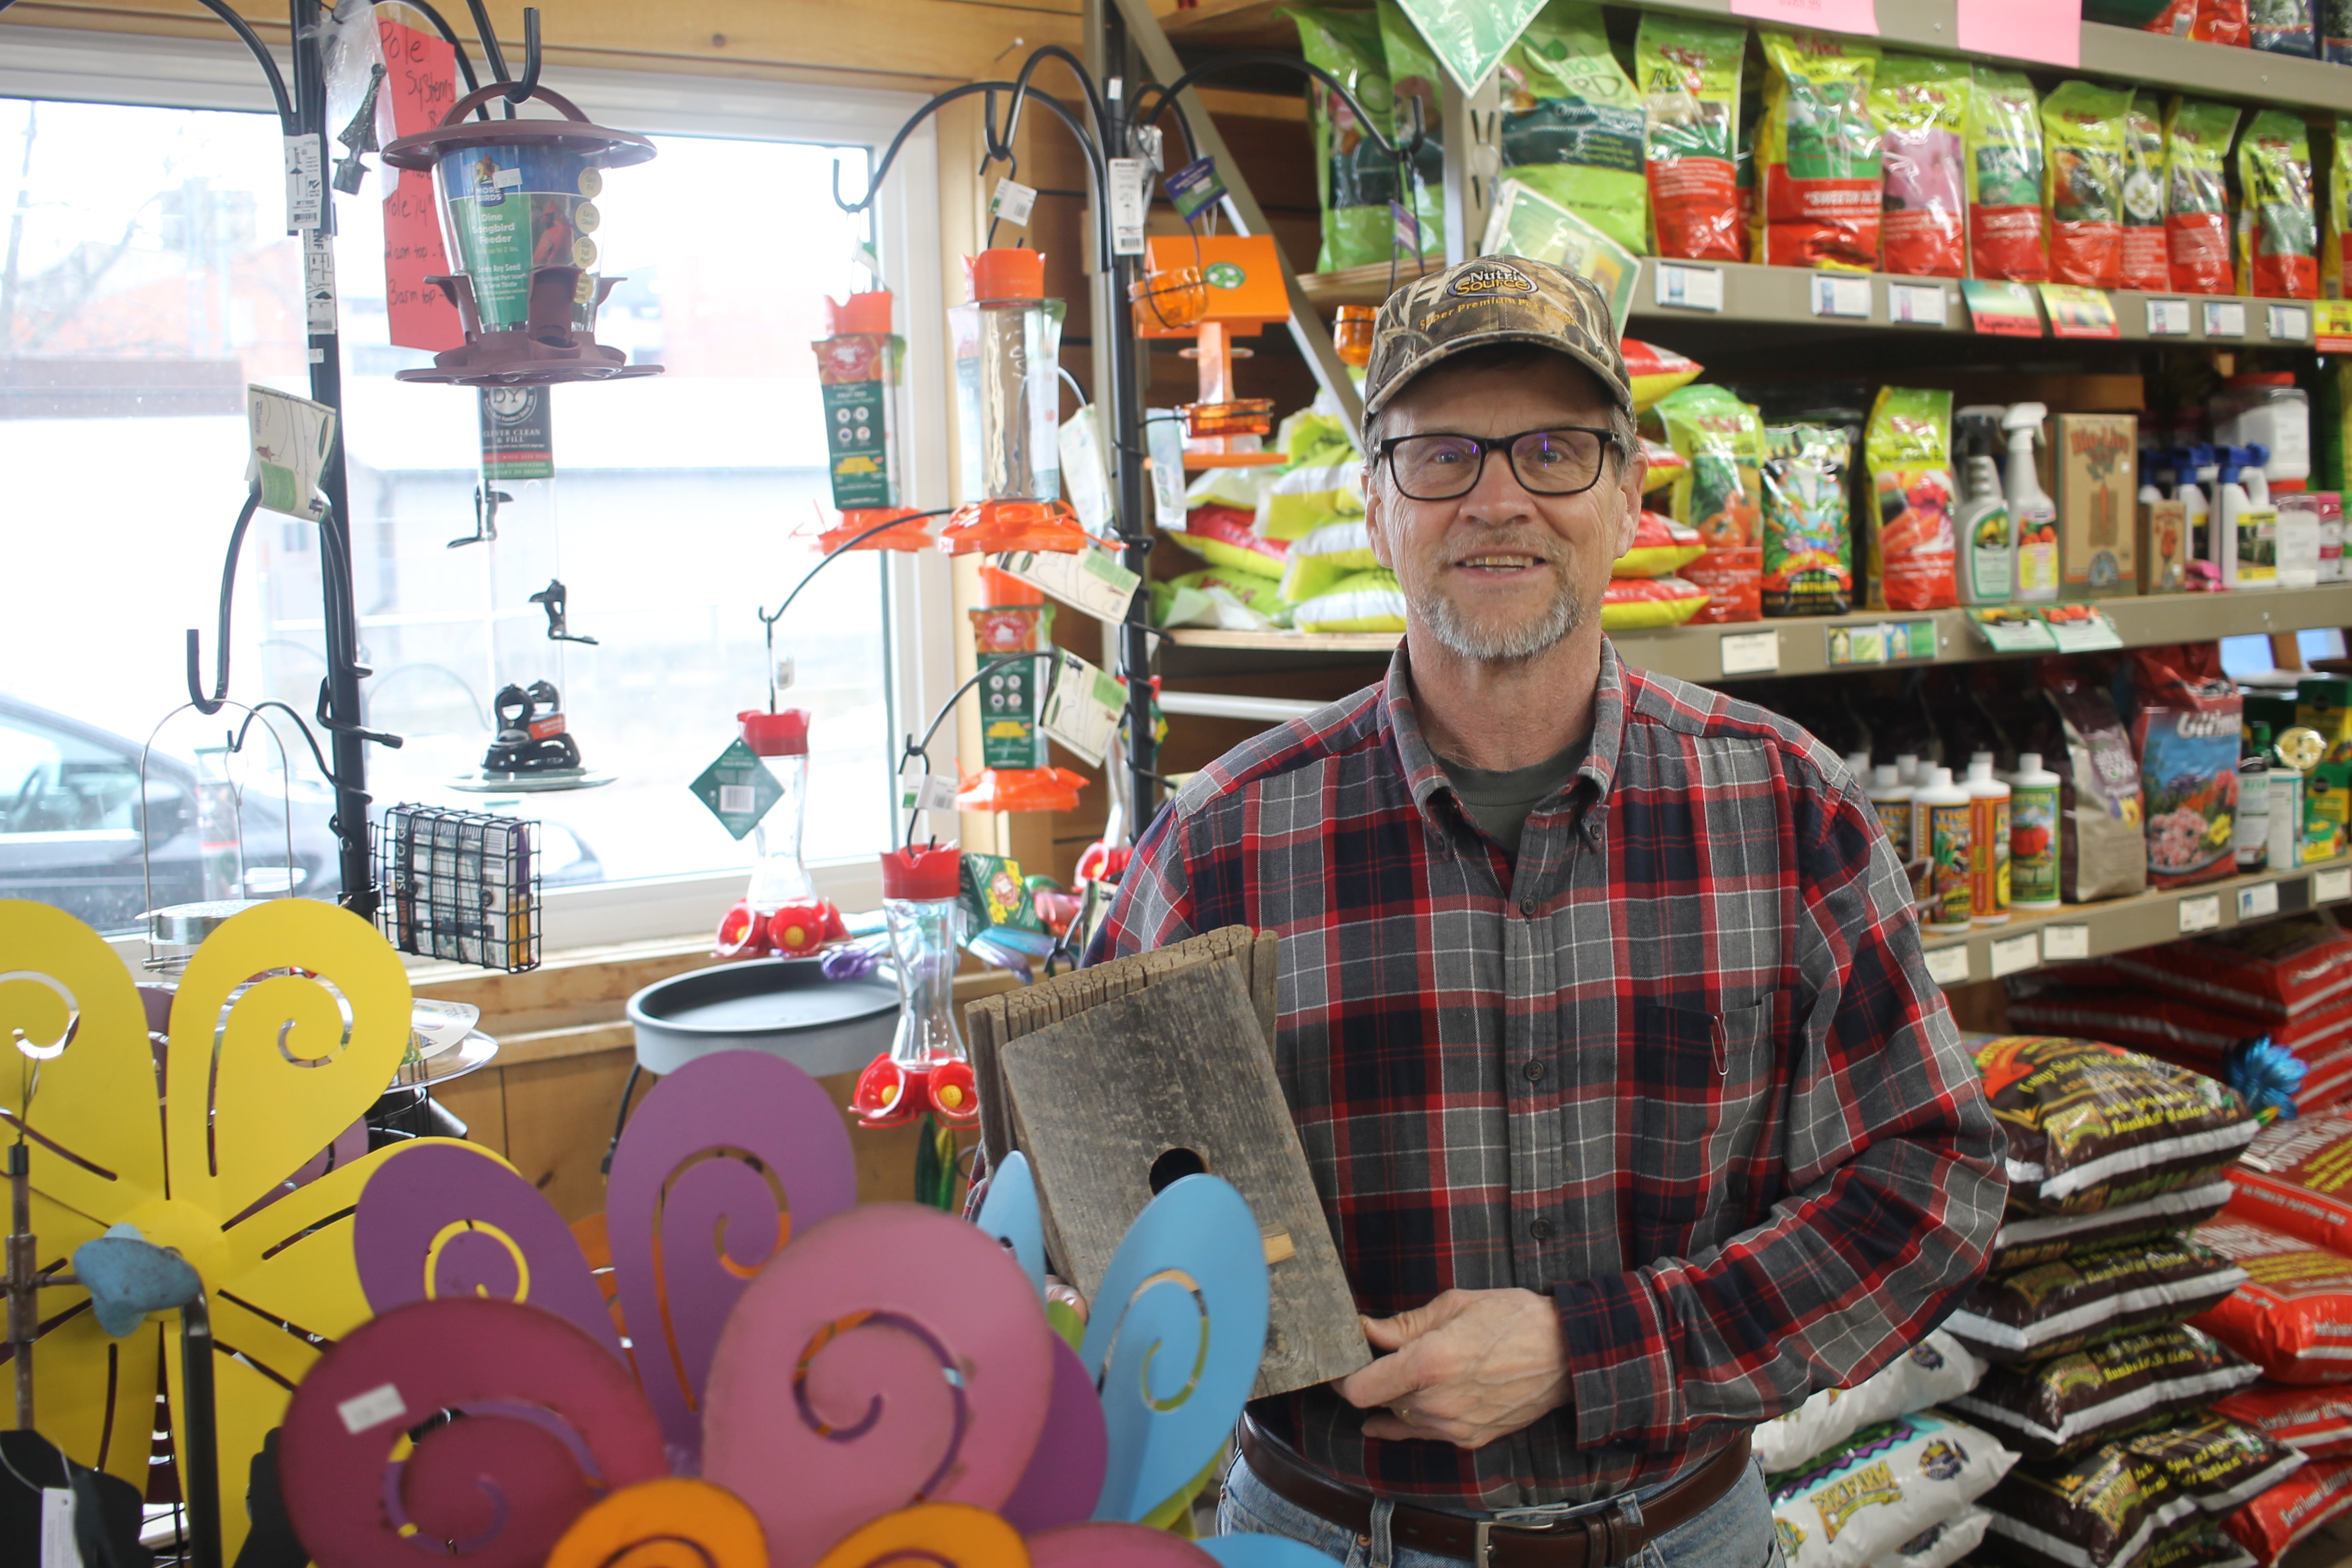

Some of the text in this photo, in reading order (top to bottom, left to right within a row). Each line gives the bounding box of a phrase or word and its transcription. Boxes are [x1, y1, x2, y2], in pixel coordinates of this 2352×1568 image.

[379, 21, 424, 64] Pole
[405, 69, 455, 112] Systems
[476, 194, 502, 202] BIRDS
[481, 213, 503, 221] Dine
[472, 222, 515, 234] Songbird
[478, 235, 512, 244] Feeder
[1469, 270, 1518, 283] Nutri
[1456, 279, 1530, 296] Source
[1419, 296, 1577, 330] Super Premium Pet Foods
[1842, 1460, 1899, 1499] FARM
